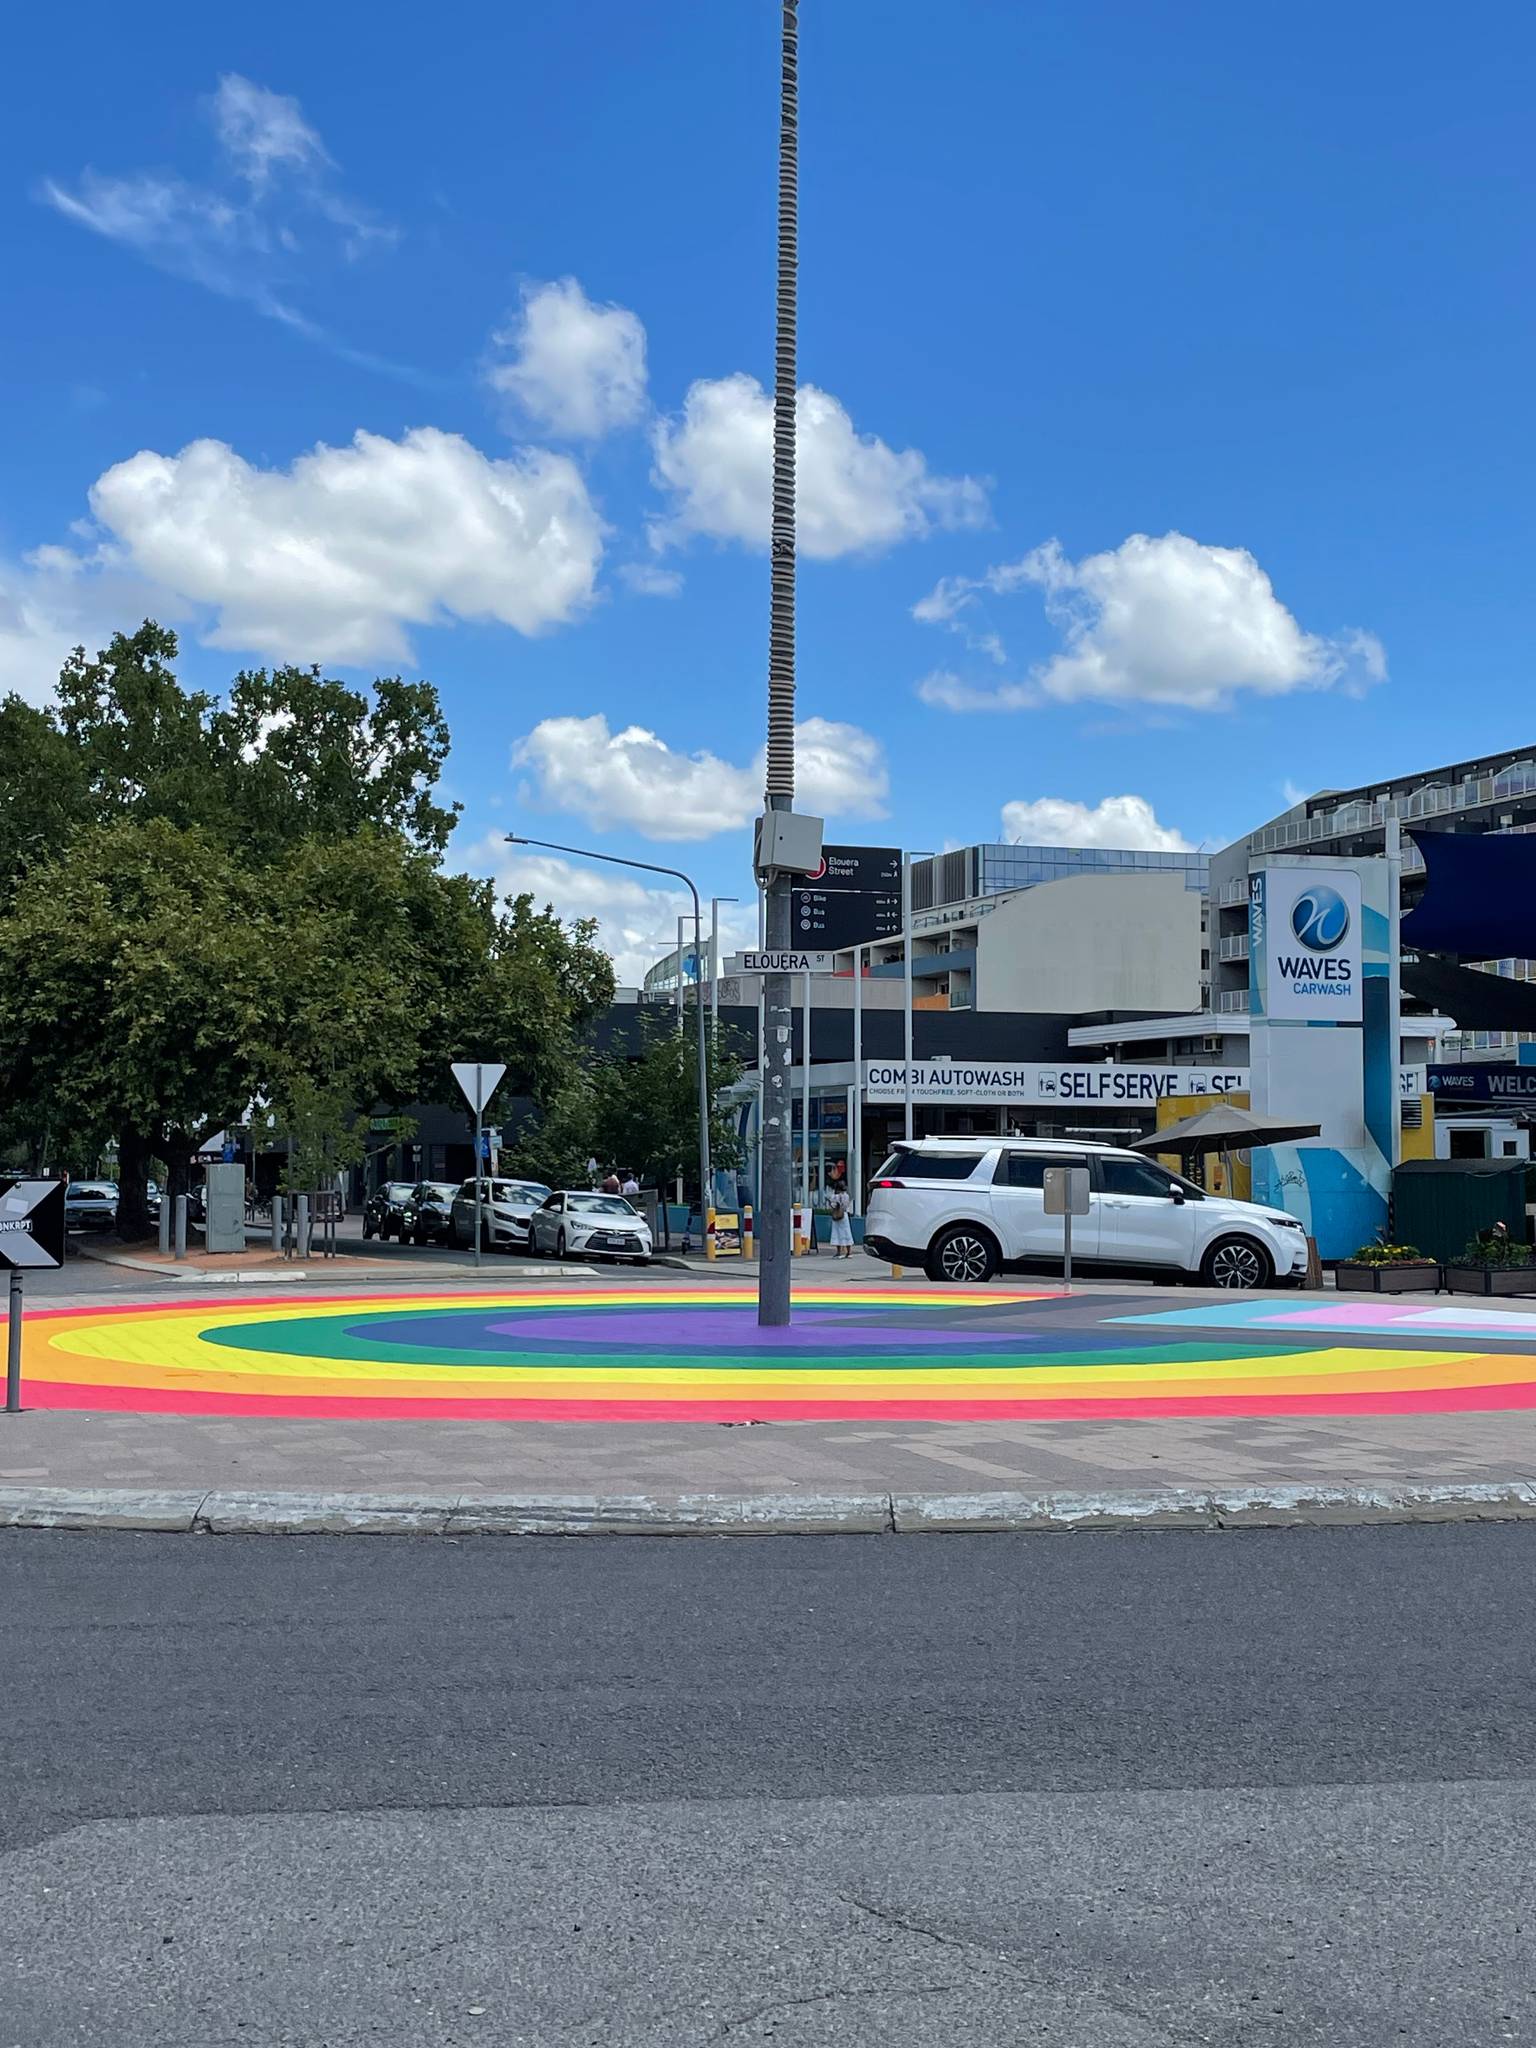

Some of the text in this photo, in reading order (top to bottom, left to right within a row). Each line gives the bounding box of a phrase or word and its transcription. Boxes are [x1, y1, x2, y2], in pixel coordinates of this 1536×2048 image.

[829, 857, 859, 867] Elouera
[828, 866, 854, 876] Street
[1252, 878, 1263, 947] WAVES
[744, 954, 825, 969] ELOUERA ST
[1278, 956, 1352, 981] WAVES
[1293, 982, 1352, 996] CARWASH
[869, 1068, 1025, 1087] COMBI AUTOWASH
[1442, 1075, 1475, 1087] WAVES
[868, 1087, 895, 1095] CHOOSE
